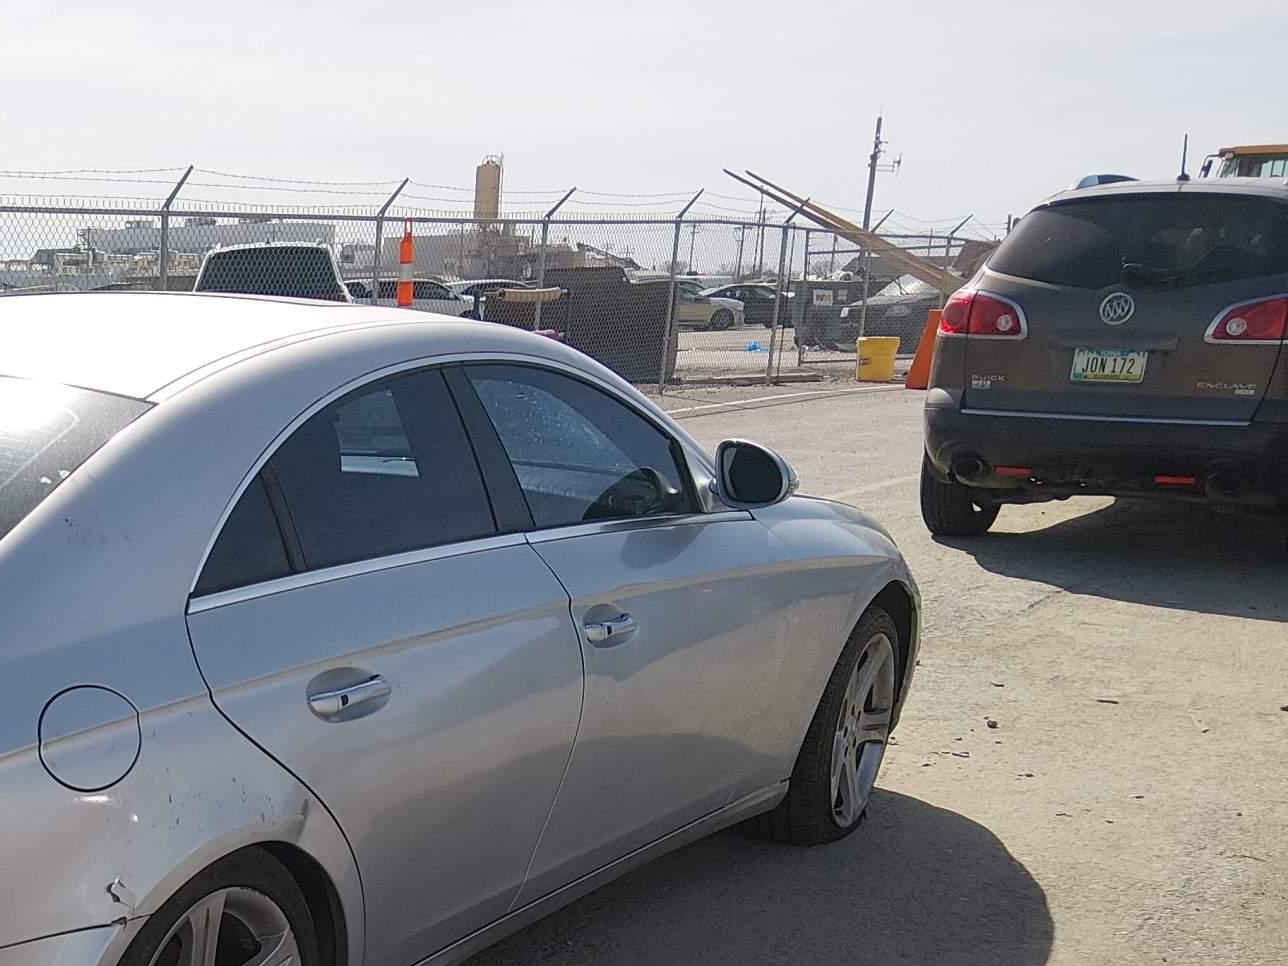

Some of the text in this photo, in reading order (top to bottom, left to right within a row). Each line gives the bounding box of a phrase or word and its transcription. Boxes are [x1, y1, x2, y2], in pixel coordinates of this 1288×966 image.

[1082, 357, 1136, 374] JON 172
[1197, 382, 1256, 390] ENCLAVE
